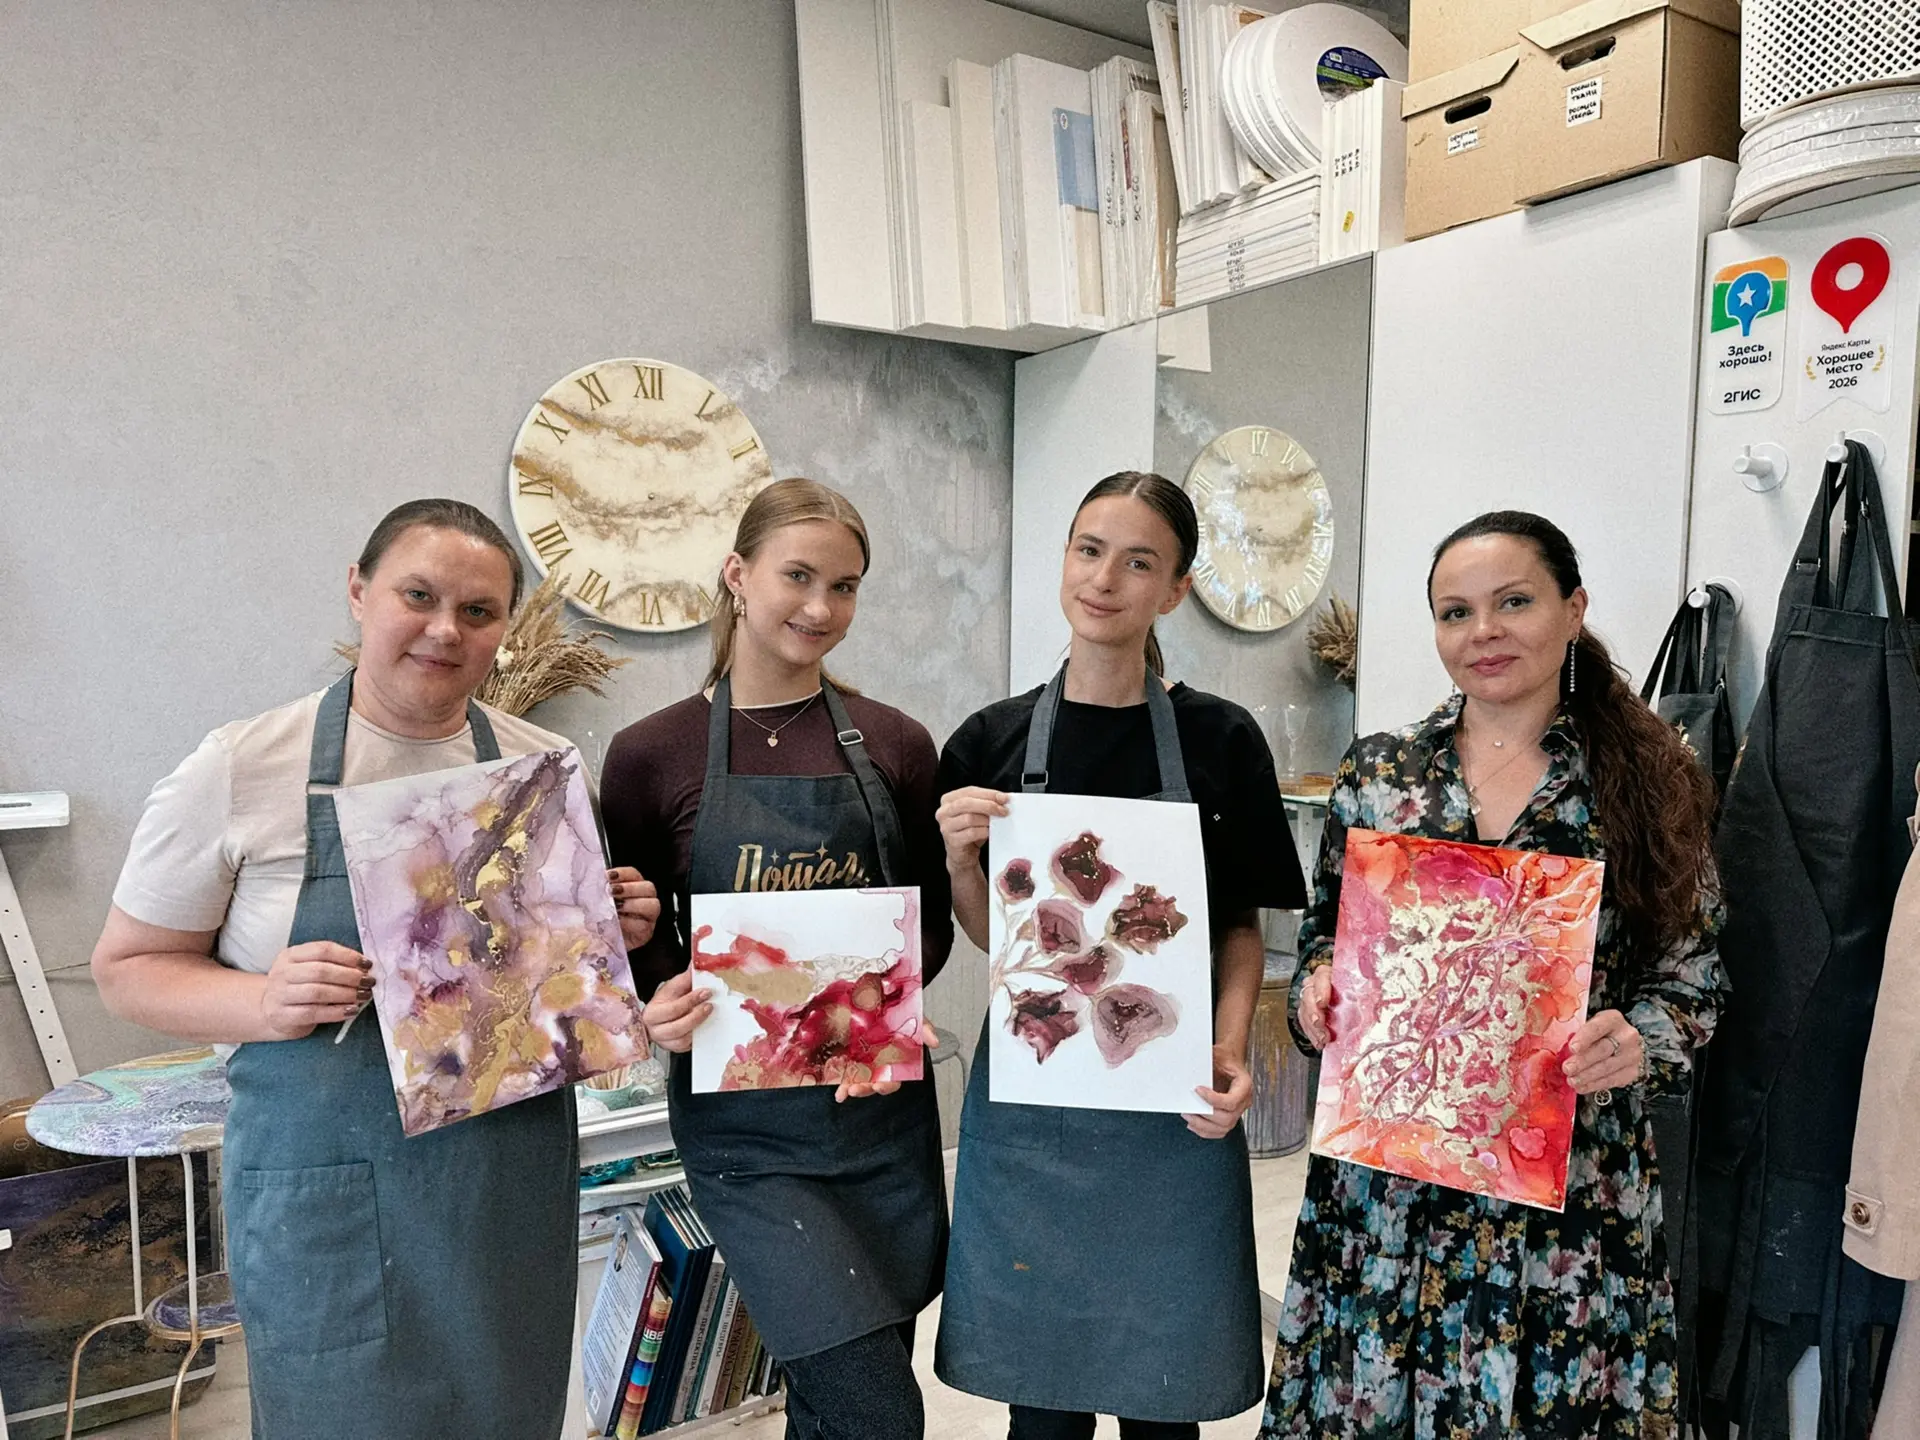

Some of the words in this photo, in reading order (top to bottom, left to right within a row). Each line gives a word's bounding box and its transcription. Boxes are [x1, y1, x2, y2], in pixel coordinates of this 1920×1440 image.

[1728, 344, 1765, 356] Здесь
[1816, 350, 1874, 366] Хорошее
[1821, 342, 1846, 352] Яндекс
[1847, 338, 1871, 347] Карты
[1719, 352, 1772, 368] хорошо!
[1826, 363, 1863, 376] место
[575, 372, 612, 411] XI
[633, 365, 664, 400] XII
[1828, 376, 1858, 389] 2026
[1723, 389, 1761, 404] 2ГИС
[533, 412, 570, 444] X
[518, 471, 554, 498] IX
[528, 520, 573, 569] VIII
[574, 568, 612, 608] VII
[640, 592, 664, 625] VI
[689, 1317, 708, 1370] ПЕРСПЕКТИВА
